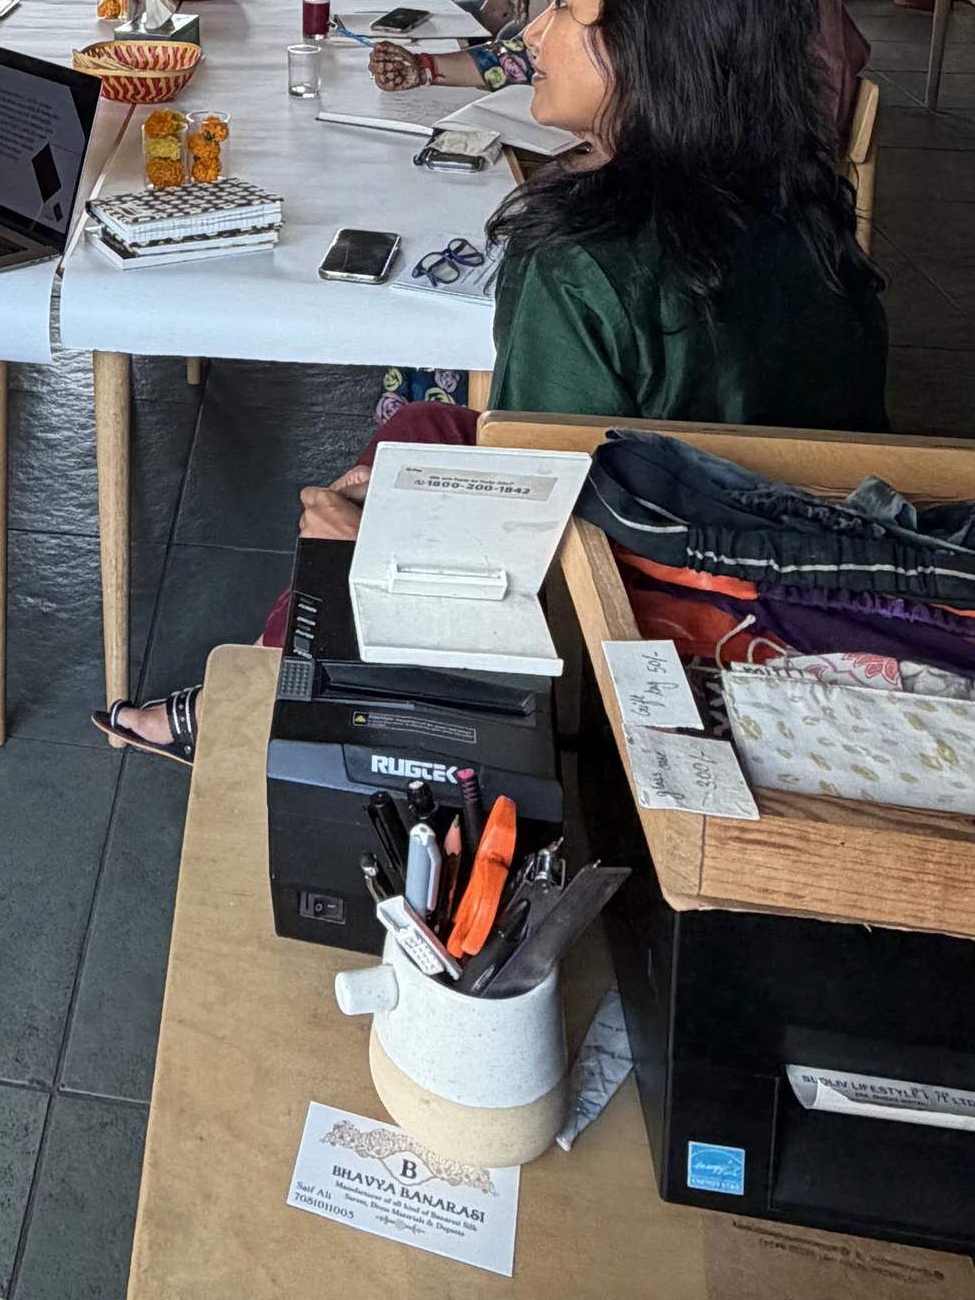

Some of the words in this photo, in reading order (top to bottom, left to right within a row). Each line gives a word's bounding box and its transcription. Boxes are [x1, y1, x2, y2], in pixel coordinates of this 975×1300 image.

[427, 479, 530, 495] 1800-200-1842
[401, 1159, 418, 1180] B
[332, 1165, 396, 1196] BHAVYA
[400, 1186, 486, 1223] BANARASI
[335, 1180, 382, 1201] Manufacturer
